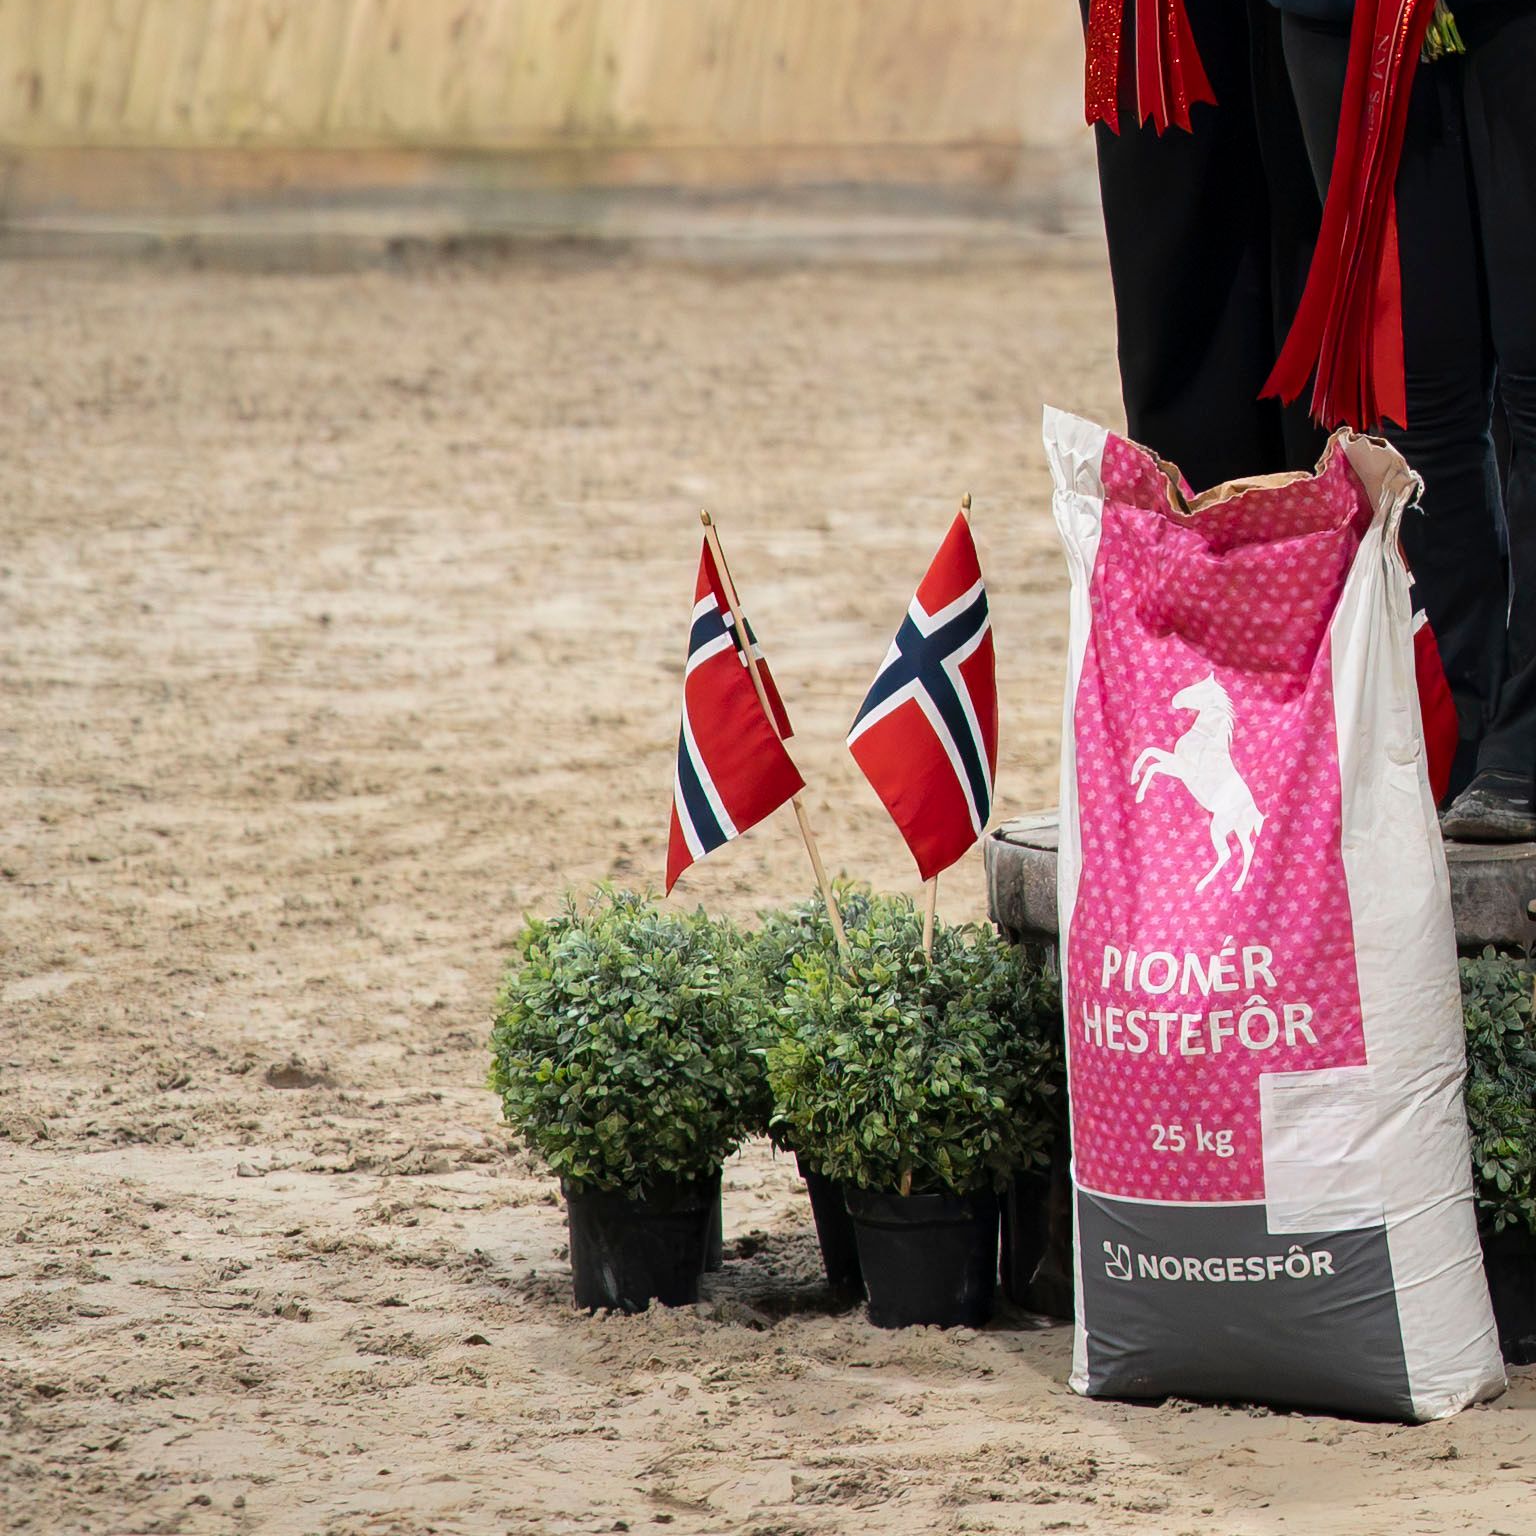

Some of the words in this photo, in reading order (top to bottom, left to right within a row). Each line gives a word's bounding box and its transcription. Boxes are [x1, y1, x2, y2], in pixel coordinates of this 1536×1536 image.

[1102, 935, 1279, 997] PIONÉR
[1082, 994, 1319, 1056] HESTEFÔR
[1150, 1124, 1186, 1152] 25
[1197, 1123, 1235, 1158] kg
[1137, 1244, 1336, 1282] NORGESFÔR
